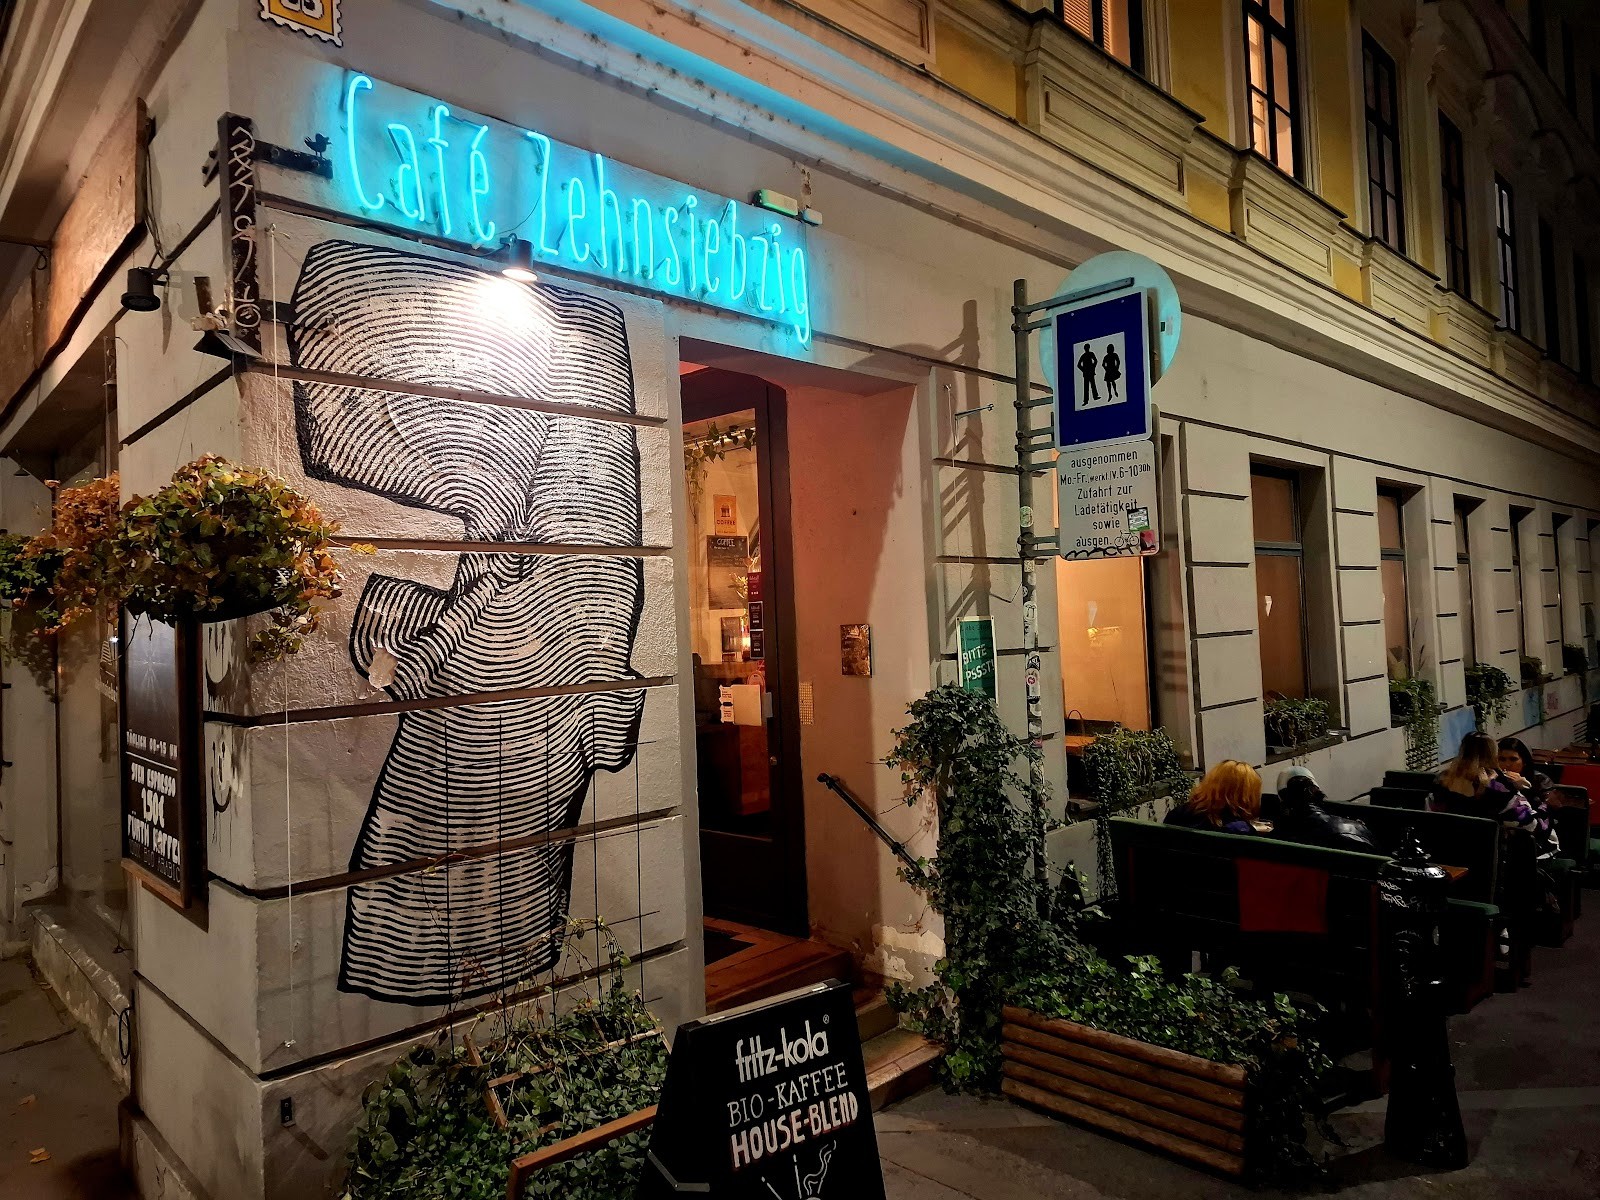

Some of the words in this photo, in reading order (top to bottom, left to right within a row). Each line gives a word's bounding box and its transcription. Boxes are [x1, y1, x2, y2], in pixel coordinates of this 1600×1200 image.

[347, 75, 496, 241] Café
[526, 131, 811, 345] Zehnsiebzig
[1070, 450, 1138, 469] ausgenommen
[1077, 485, 1112, 499] Zufahrt
[1117, 485, 1133, 496] zur
[1074, 499, 1138, 516] Ladetätigkeit
[1092, 516, 1121, 530] sowie
[962, 643, 987, 665] BITTE
[965, 659, 995, 681] PSSST!
[735, 1019, 830, 1083] fritz-kola
[730, 1091, 859, 1168] HOUSE-BLEND
